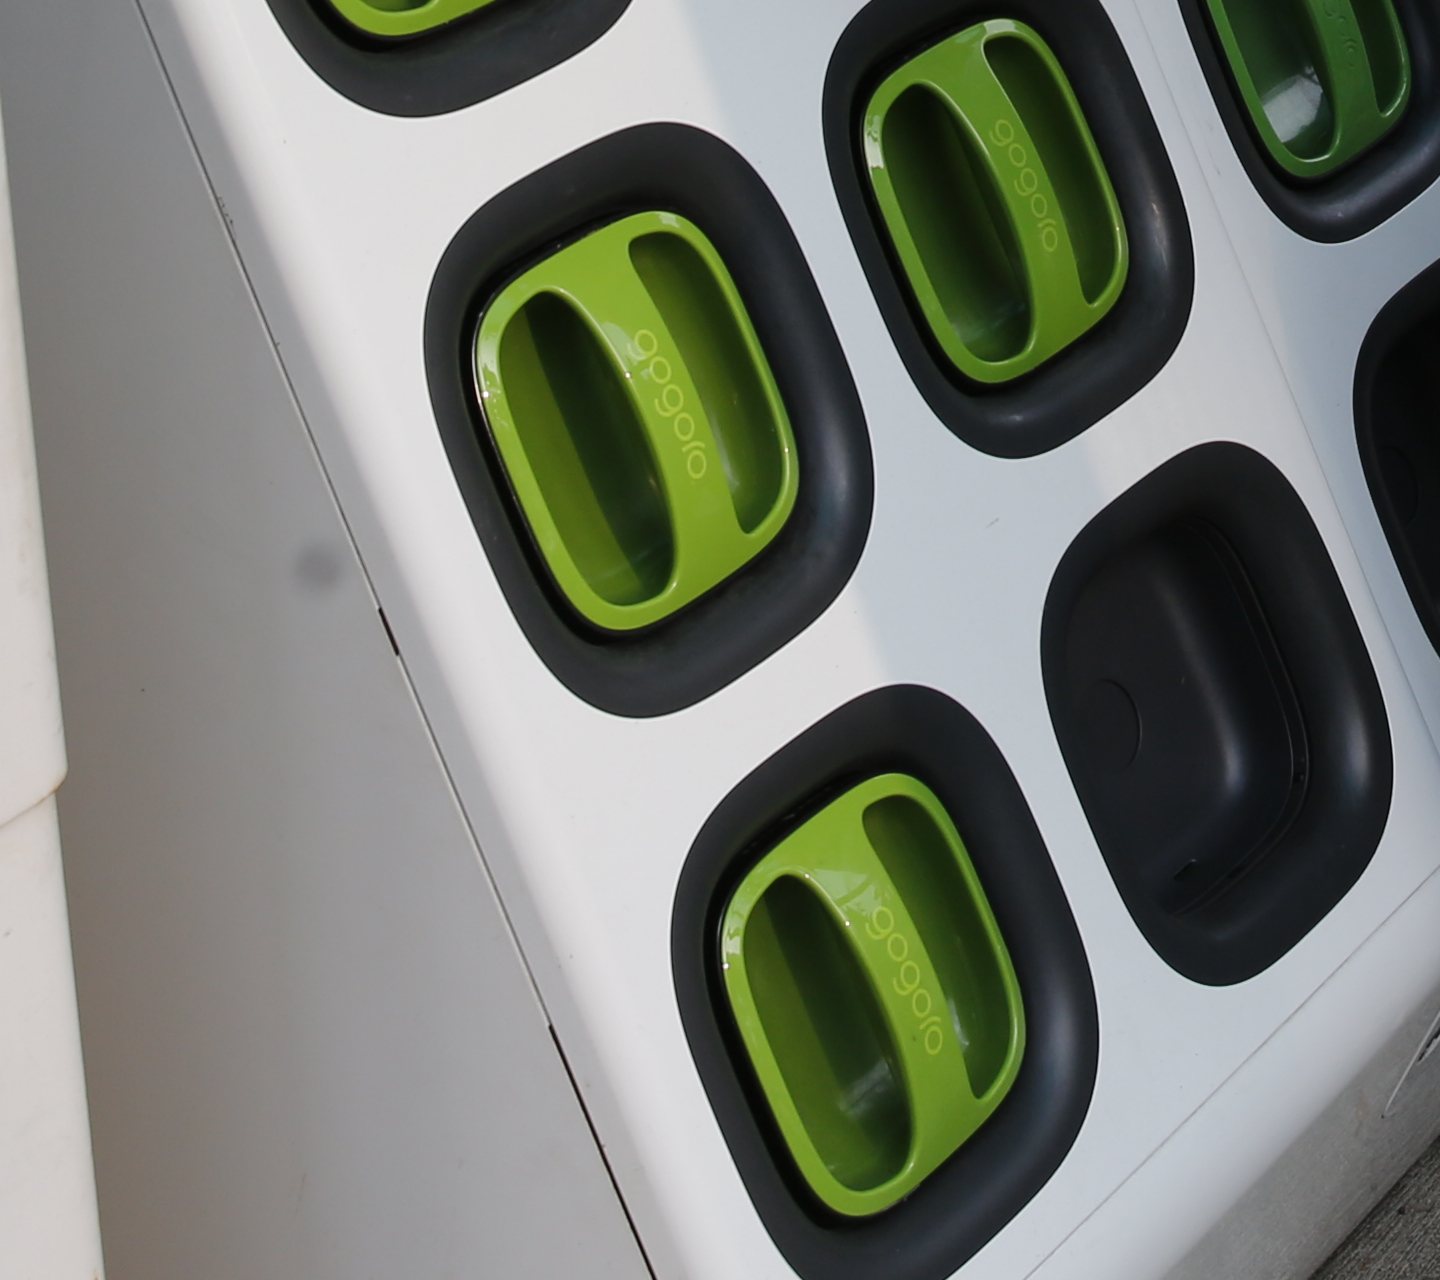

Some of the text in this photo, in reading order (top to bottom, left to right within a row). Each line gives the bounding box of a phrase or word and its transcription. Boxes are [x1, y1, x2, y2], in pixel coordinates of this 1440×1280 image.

[990, 119, 1059, 253] gogoro
[626, 329, 707, 479] gogoro
[864, 905, 944, 1056] gogoro
